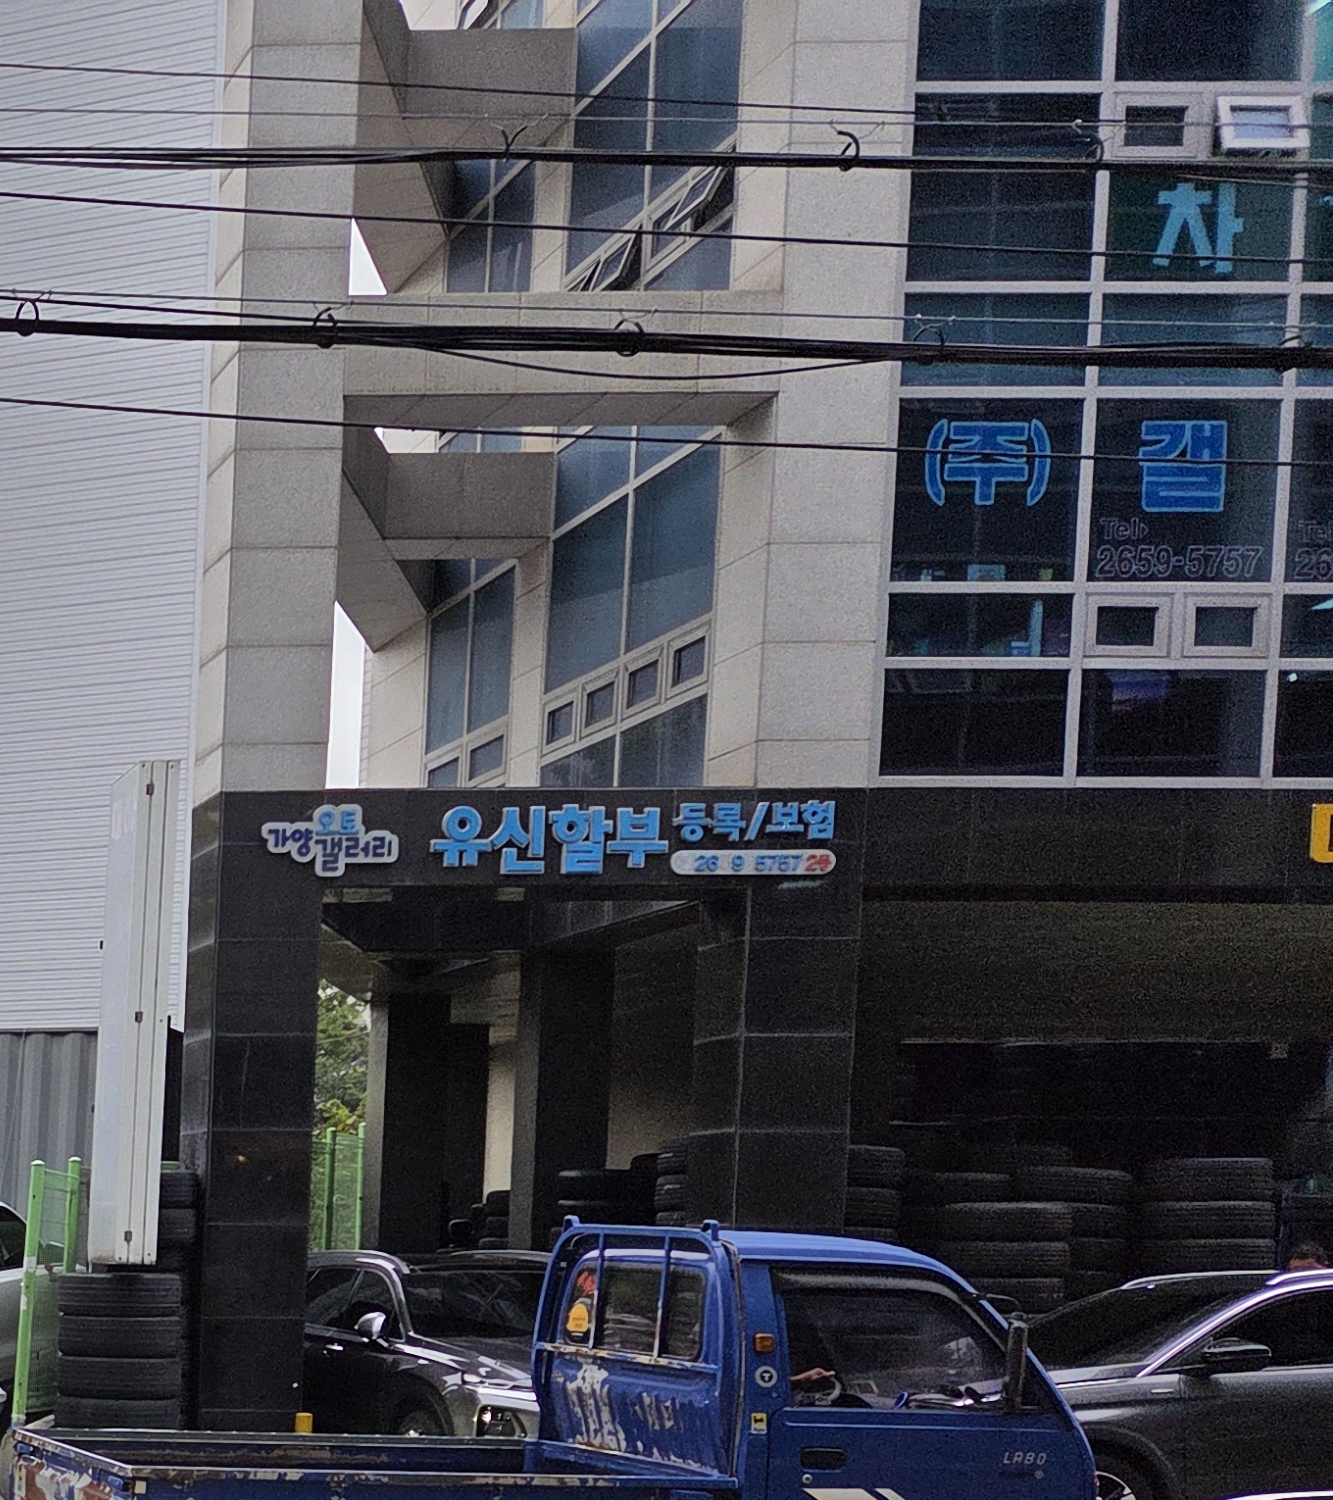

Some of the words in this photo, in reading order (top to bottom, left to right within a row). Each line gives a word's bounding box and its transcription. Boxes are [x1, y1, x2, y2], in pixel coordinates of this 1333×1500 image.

[1152, 182, 1245, 274] 차
[925, 418, 1052, 507] (주)
[1139, 420, 1228, 513] 갤
[1095, 545, 1264, 578] 2659-5757
[315, 809, 359, 836] 오토
[430, 804, 669, 875] 유신할부
[672, 800, 836, 842] 등록/보험
[268, 828, 314, 857] 가양
[314, 836, 393, 872] 갤러리
[1002, 1451, 1048, 1466] LABO
